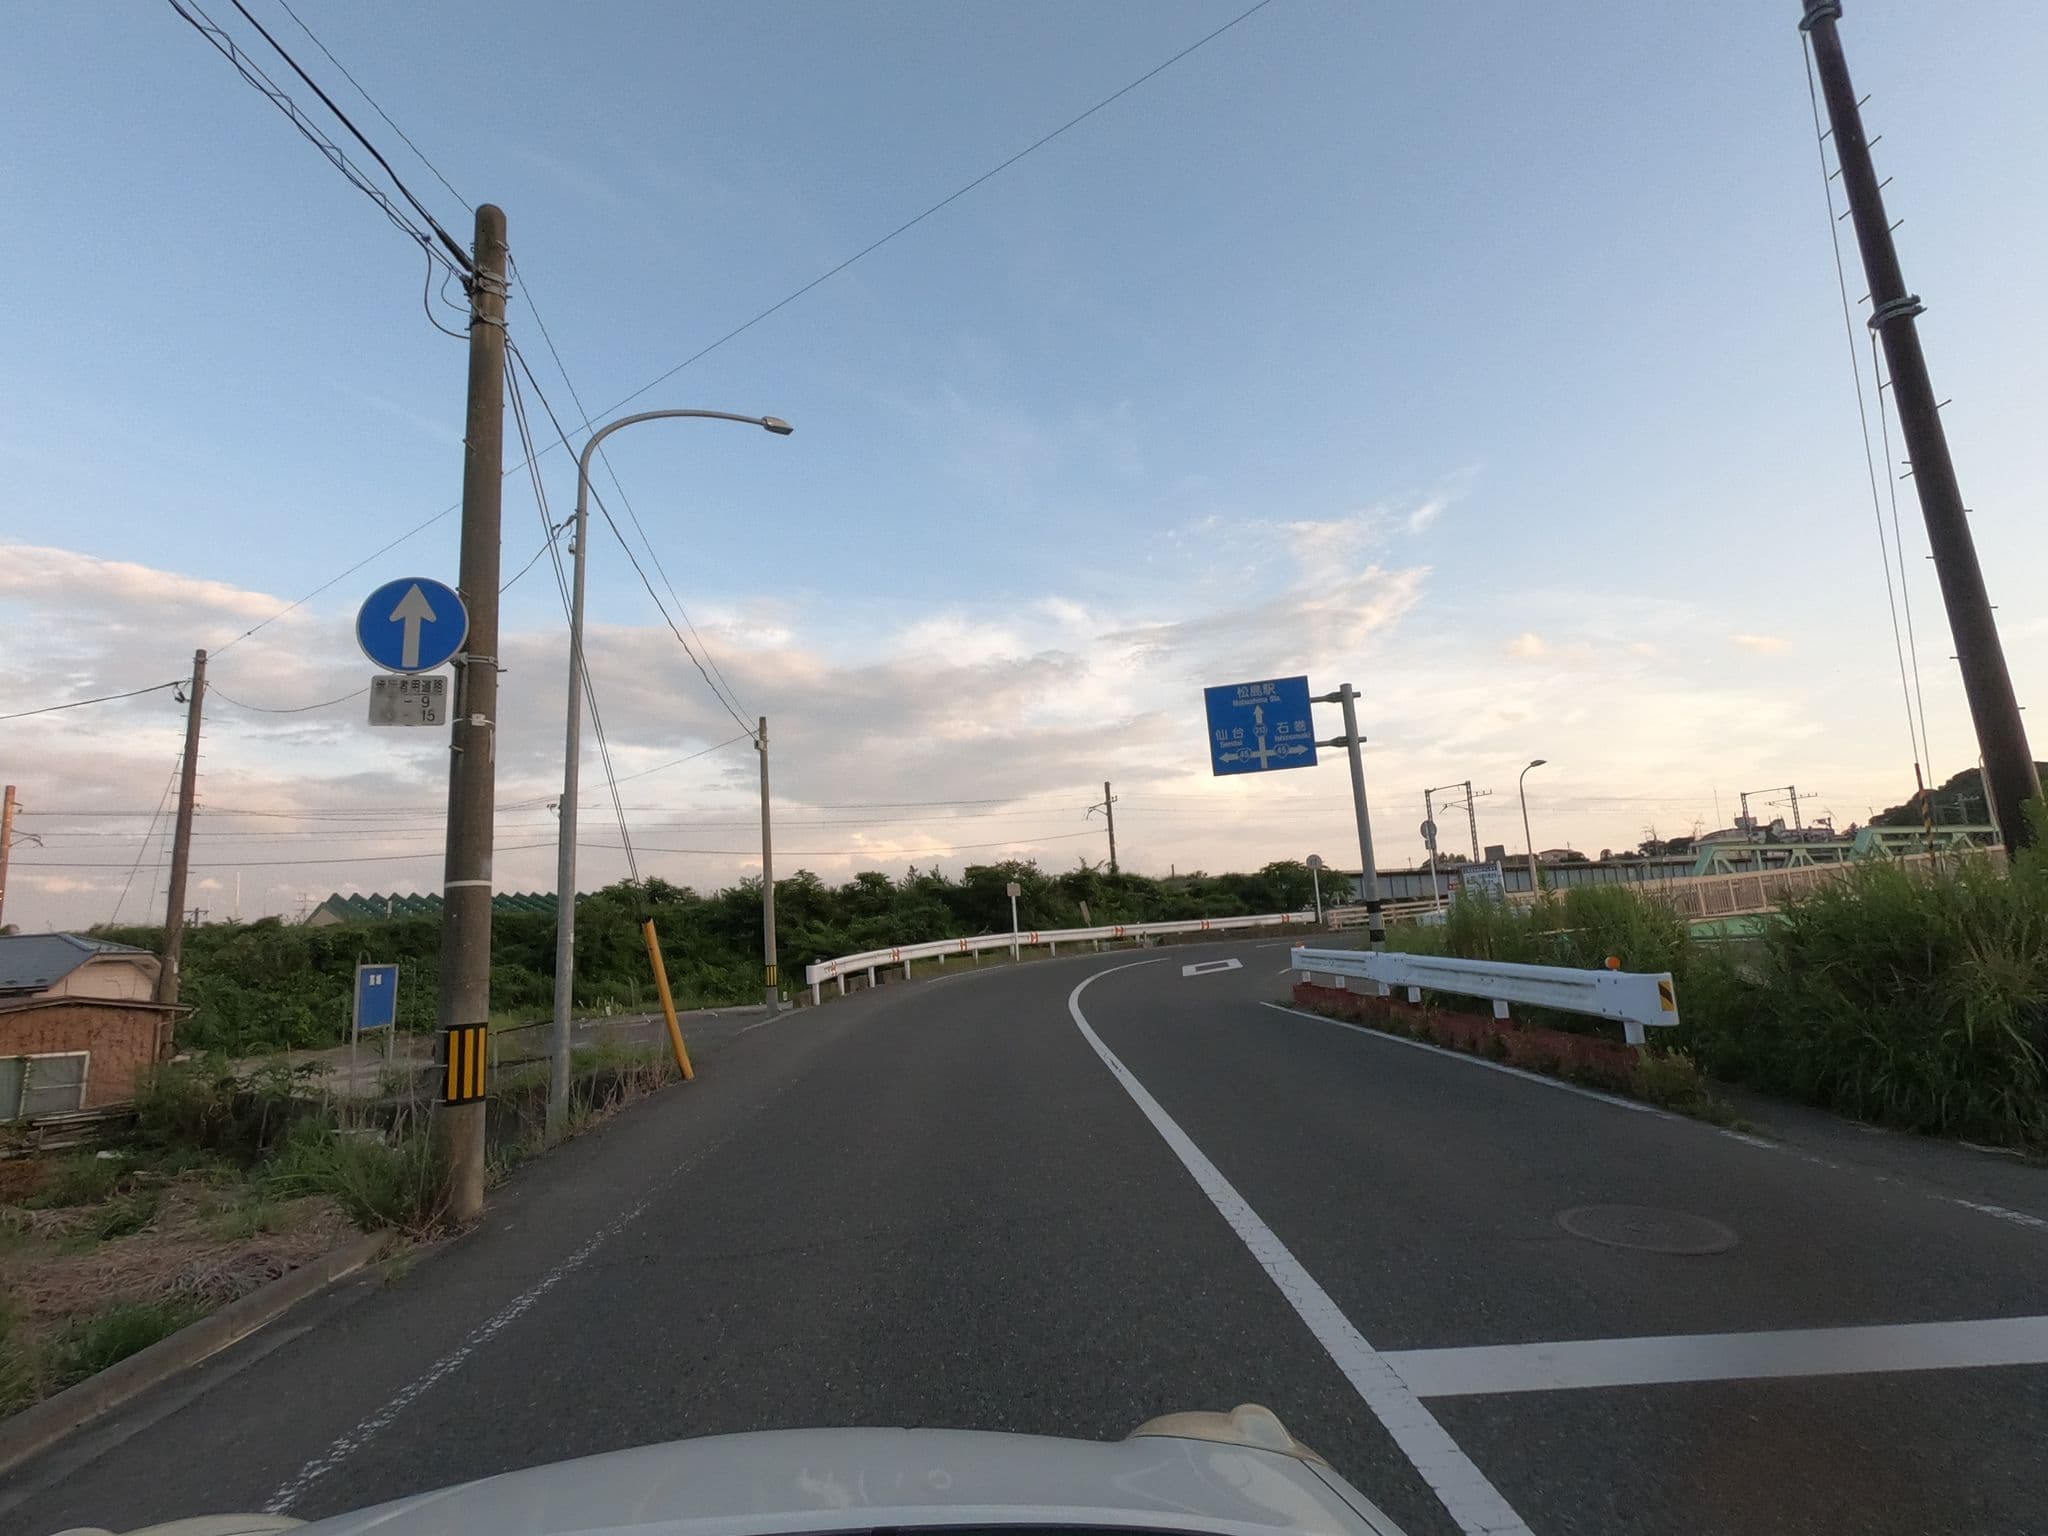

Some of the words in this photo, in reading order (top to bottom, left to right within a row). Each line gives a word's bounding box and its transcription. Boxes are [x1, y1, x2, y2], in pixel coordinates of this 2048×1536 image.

[1236, 683, 1276, 699] 松島駅
[1215, 727, 1244, 741] 仙台
[1276, 720, 1306, 734] 石巻
